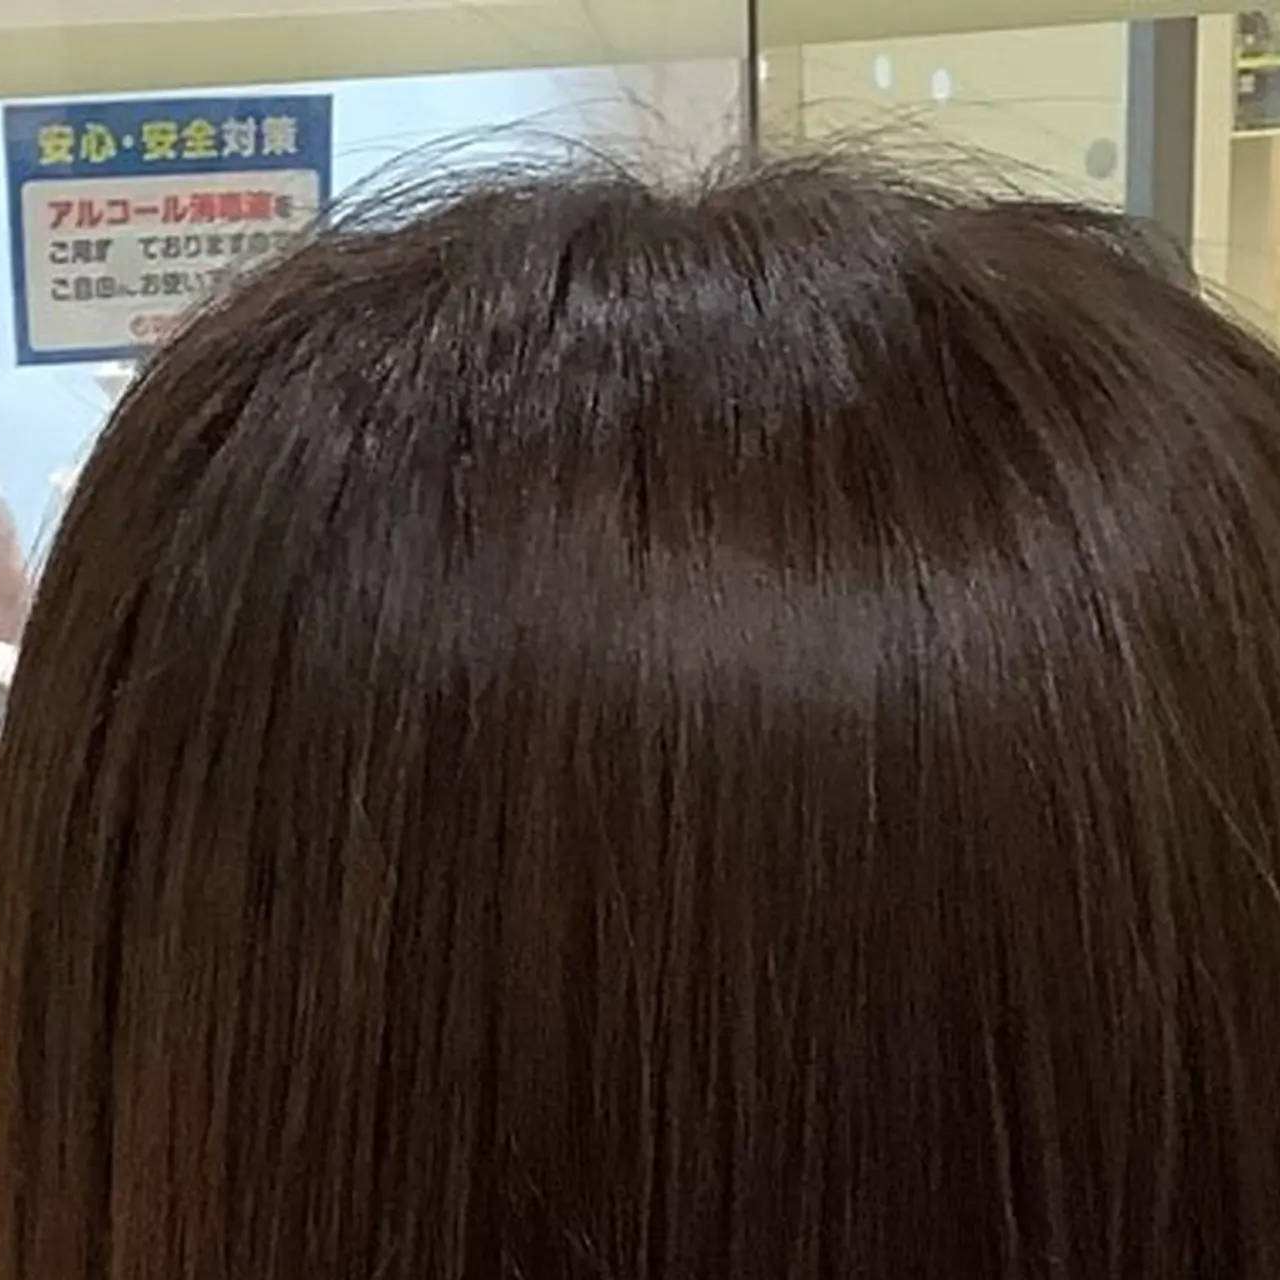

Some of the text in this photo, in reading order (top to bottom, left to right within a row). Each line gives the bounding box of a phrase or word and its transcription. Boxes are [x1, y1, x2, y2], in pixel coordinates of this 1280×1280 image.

[37, 116, 298, 165] 安心・安全対策
